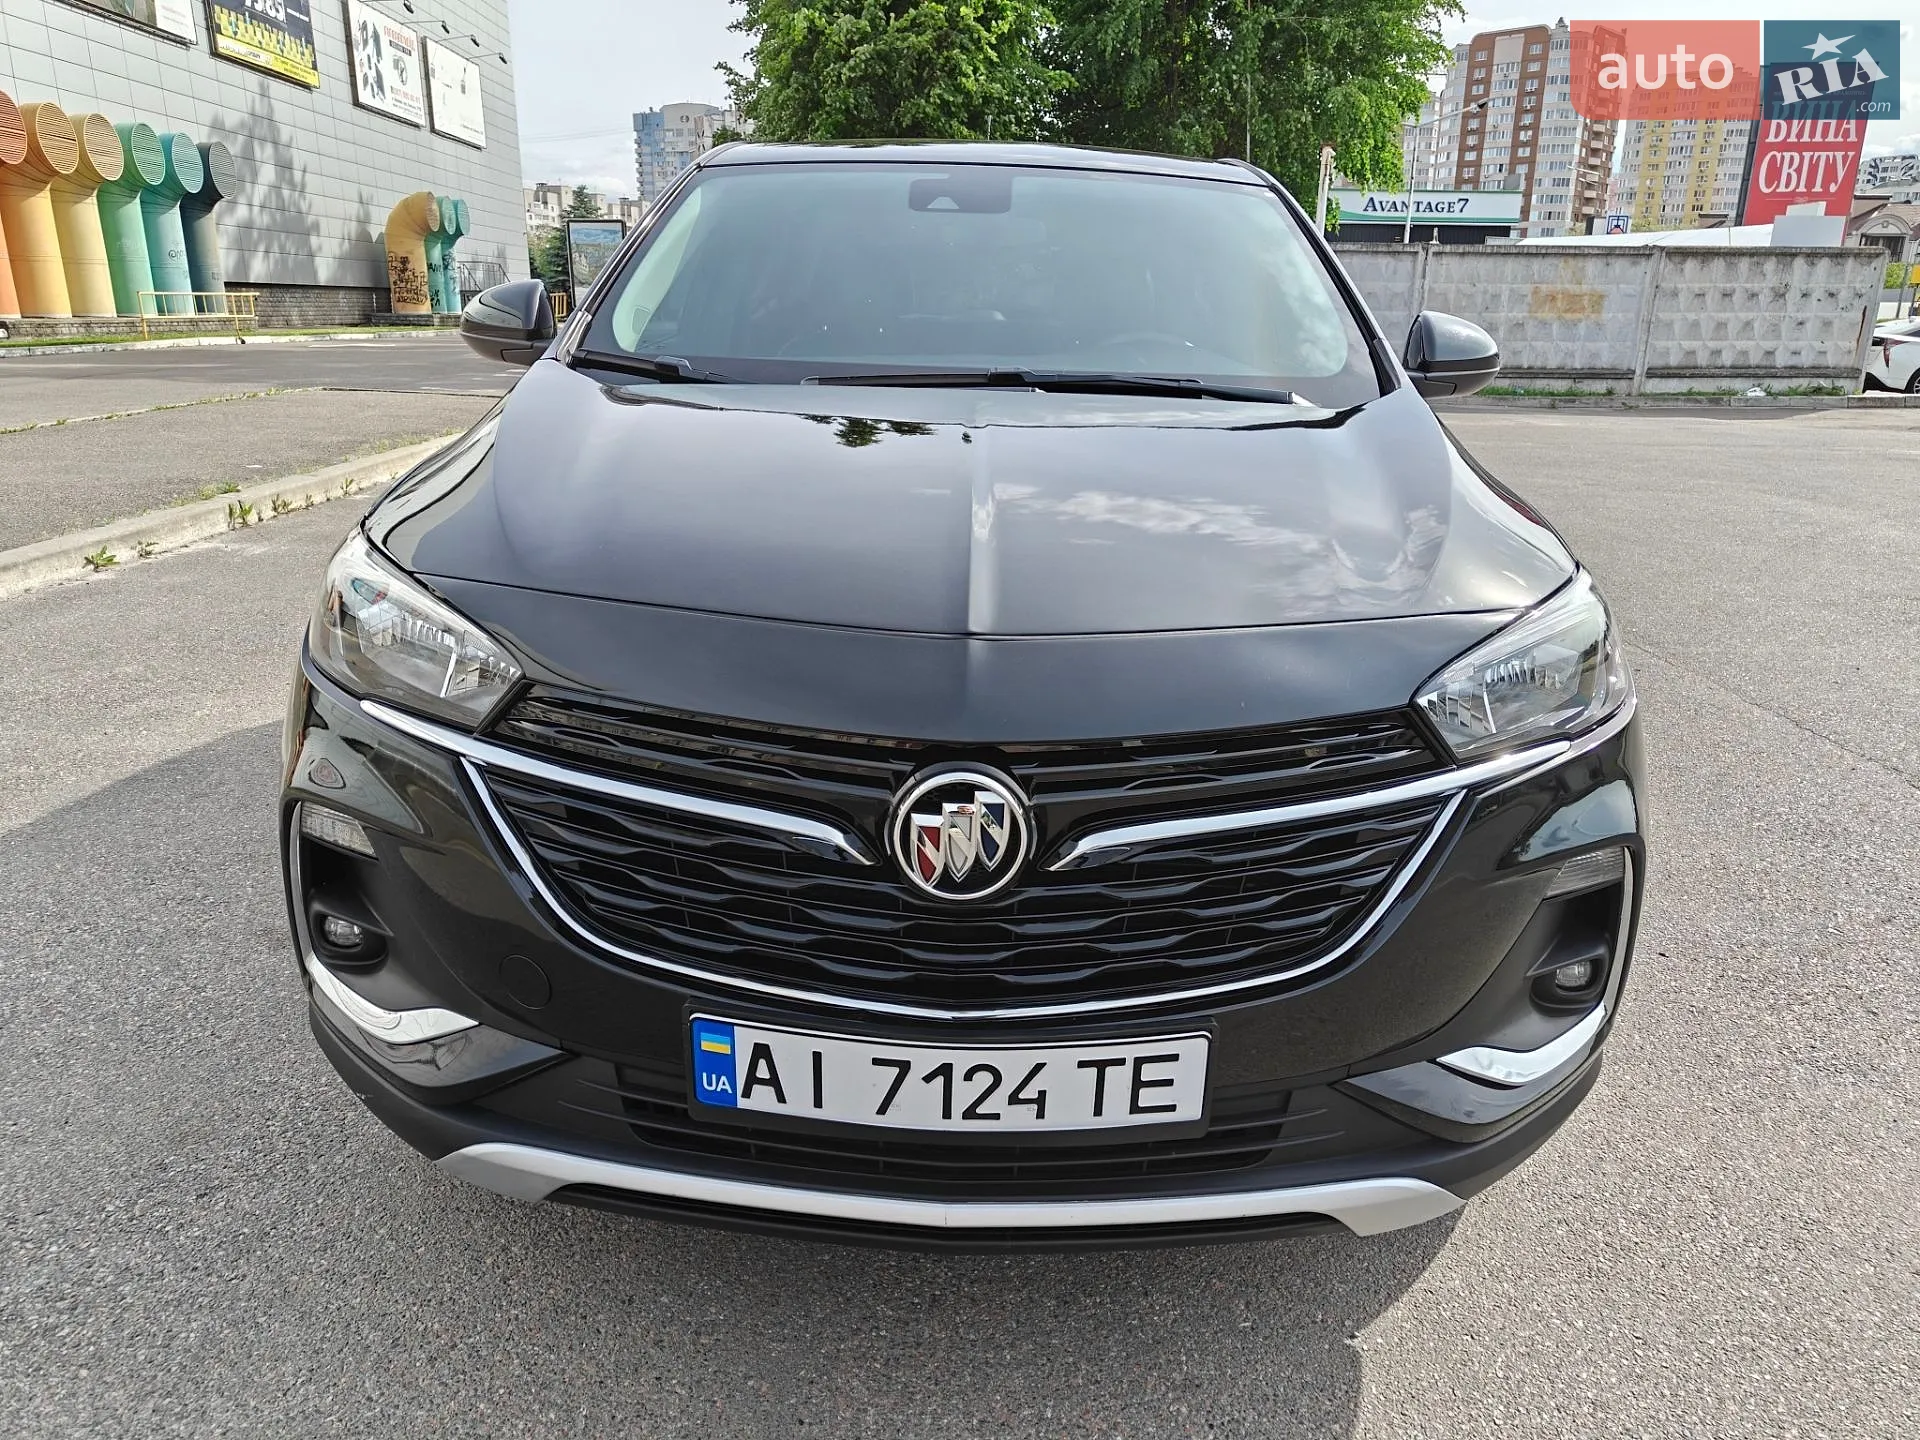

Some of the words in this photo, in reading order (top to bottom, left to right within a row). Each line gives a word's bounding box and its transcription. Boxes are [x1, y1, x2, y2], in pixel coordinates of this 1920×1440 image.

[1765, 100, 1858, 142] ВИНА
[1758, 150, 1855, 193] СВІТУ
[702, 1072, 732, 1094] UA
[740, 1042, 823, 1109] AI
[871, 1056, 1047, 1120] 7124
[1077, 1053, 1180, 1117] TE
